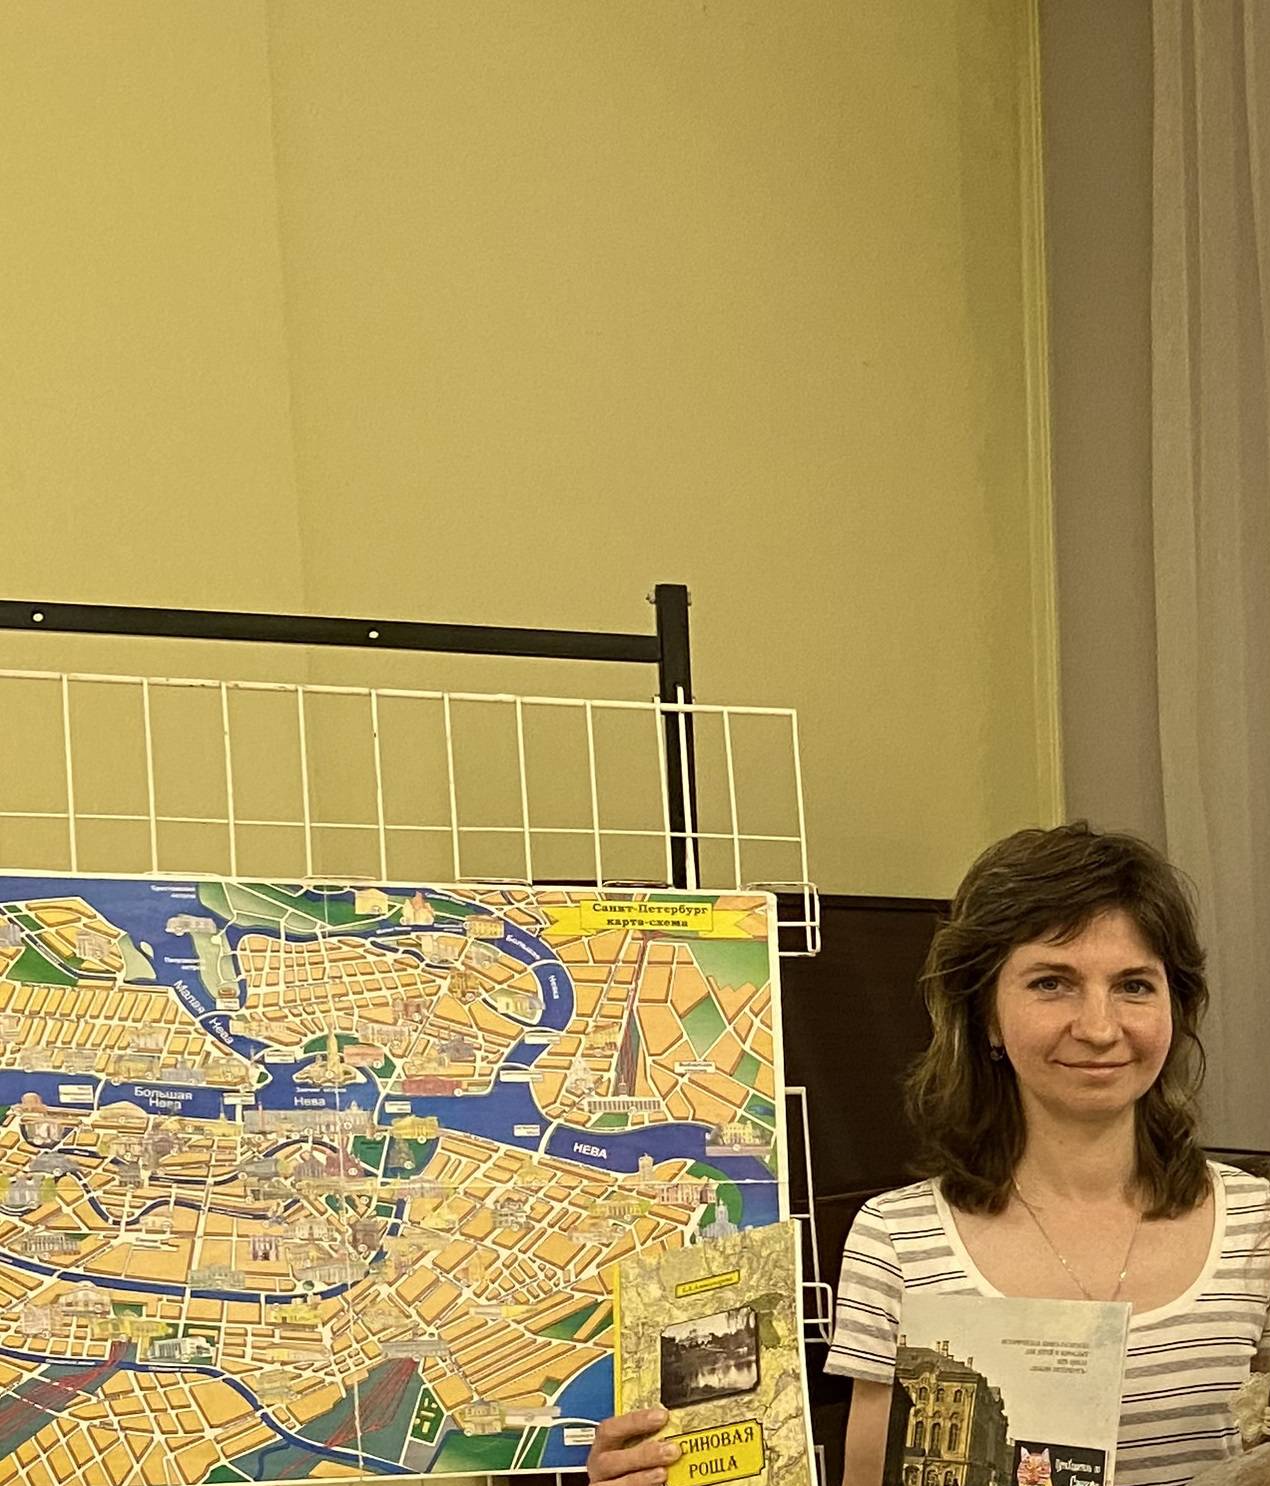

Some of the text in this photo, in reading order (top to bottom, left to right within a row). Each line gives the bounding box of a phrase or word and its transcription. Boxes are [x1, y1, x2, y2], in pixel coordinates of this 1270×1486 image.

[592, 902, 708, 915] Санкт-Петербург
[606, 918, 689, 928] карта-схема
[134, 1086, 193, 1100] Большая
[293, 1096, 326, 1107] Нева
[573, 1142, 608, 1159] НЕВА
[679, 1426, 755, 1456] СИНОВАЯ
[689, 1458, 739, 1480] РОЩА
